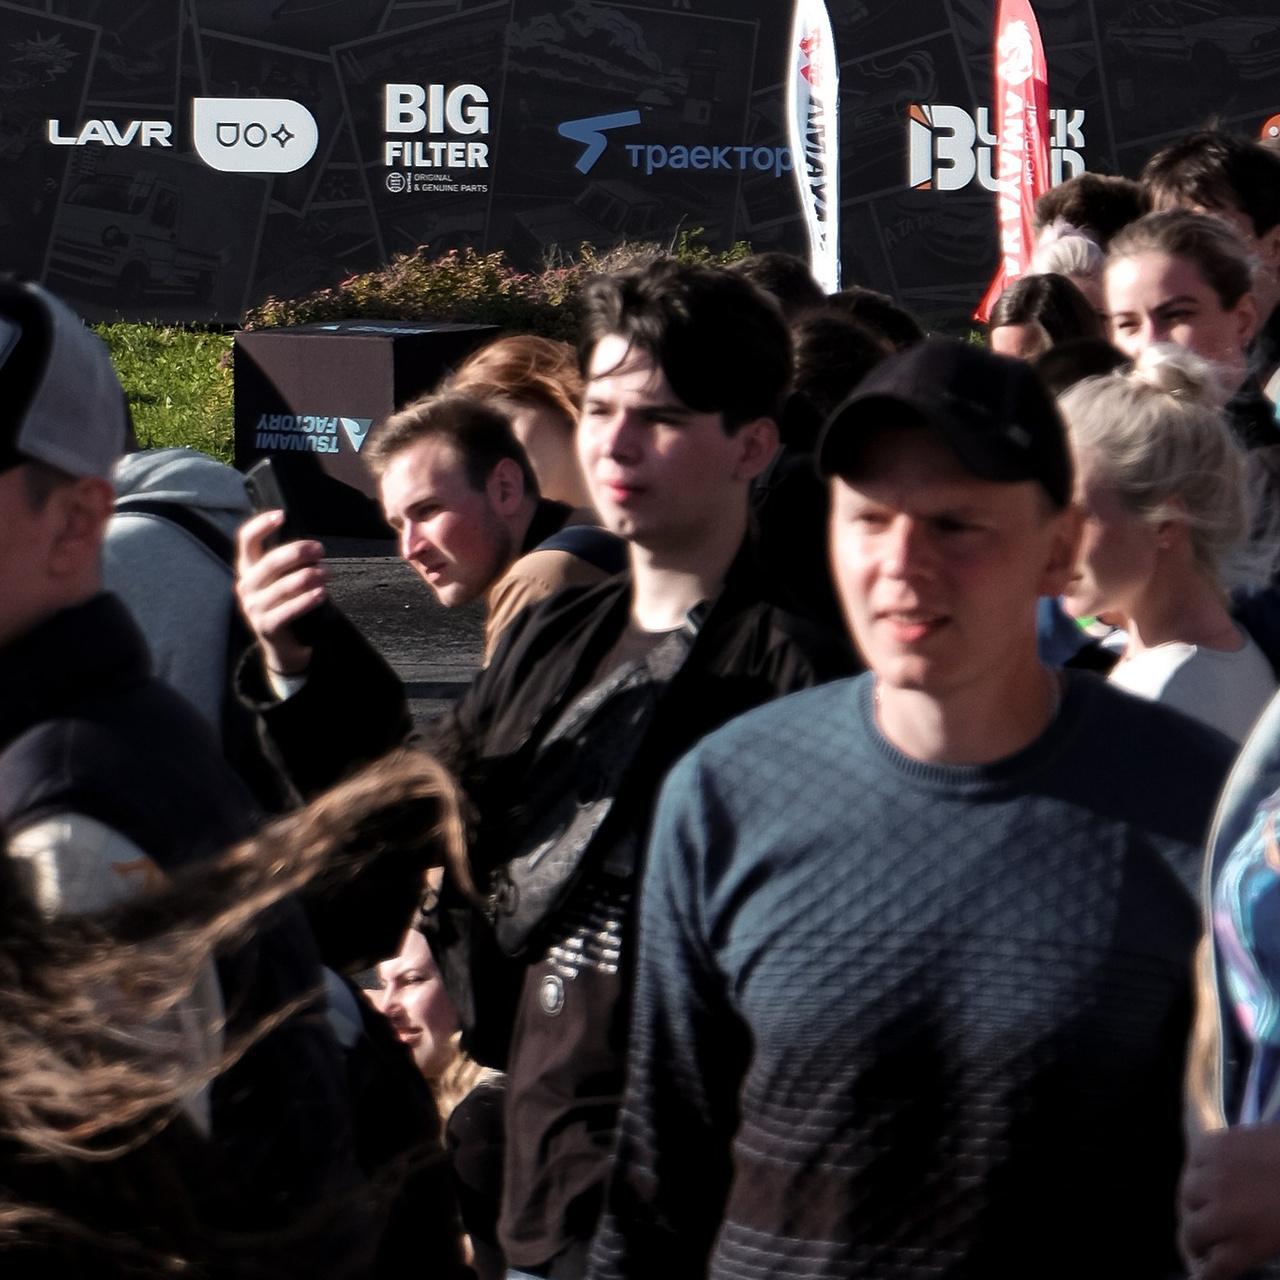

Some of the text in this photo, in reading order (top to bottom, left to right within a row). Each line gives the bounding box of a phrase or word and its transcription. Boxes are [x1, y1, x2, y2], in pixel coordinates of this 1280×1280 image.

[385, 83, 490, 135] BIG
[48, 119, 173, 147] LAVR
[385, 141, 489, 168] FILTER
[414, 173, 453, 182] ORIGINAL
[414, 183, 488, 193] & GENUINE PARTS
[256, 413, 338, 434] FACTORY
[255, 432, 339, 454] TSUNAMI
